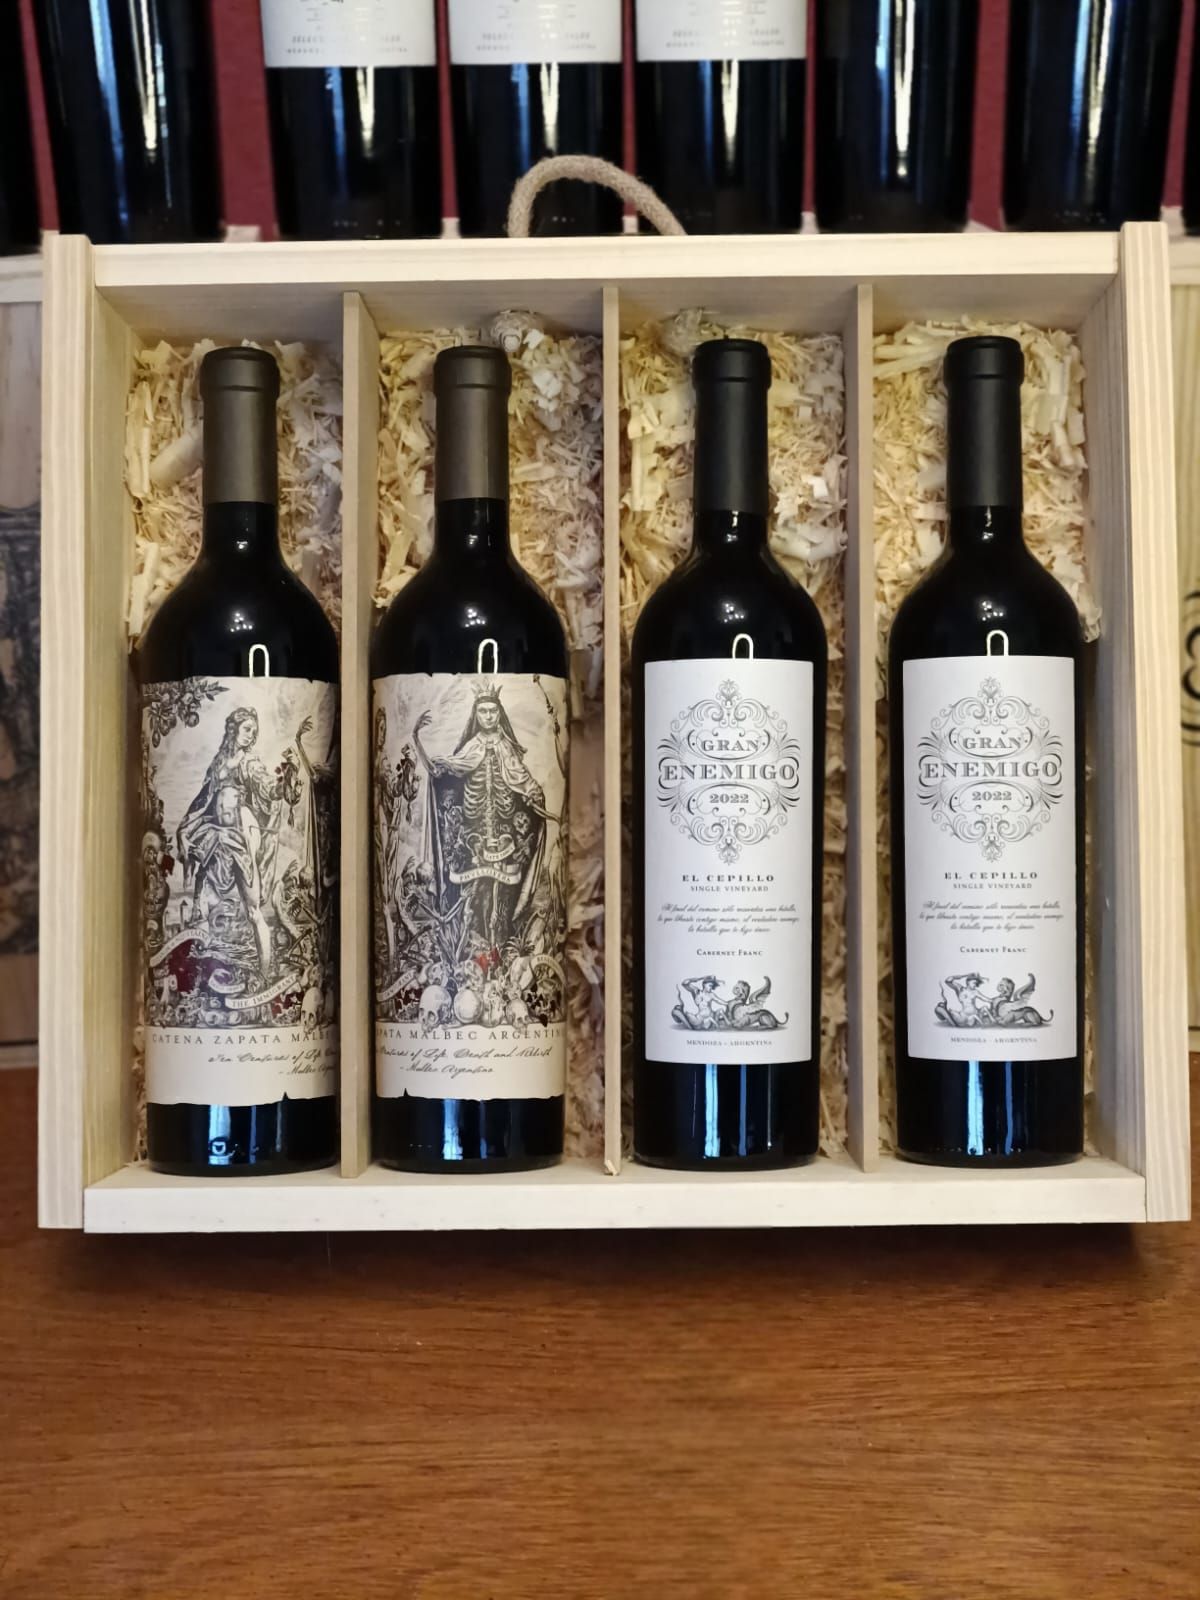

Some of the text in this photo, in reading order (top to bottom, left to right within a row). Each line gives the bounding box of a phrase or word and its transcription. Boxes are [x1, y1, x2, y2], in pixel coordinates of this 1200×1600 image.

[701, 738, 760, 752] GRAN
[963, 736, 1023, 749] GRAN
[663, 764, 796, 781] ENEMIGO
[923, 761, 1058, 779] ENEMIGO
[709, 793, 749, 804] 2022
[971, 791, 1012, 801] 2022
[682, 874, 775, 882] EL CEPILLO
[944, 871, 1038, 880] EL CEPILLO
[231, 1000, 248, 1008] THE
[152, 1034, 203, 1044] CATENA
[214, 1034, 281, 1044] ZAPATA
[409, 1029, 478, 1040] MALBEC
[494, 1046, 518, 1058] and
